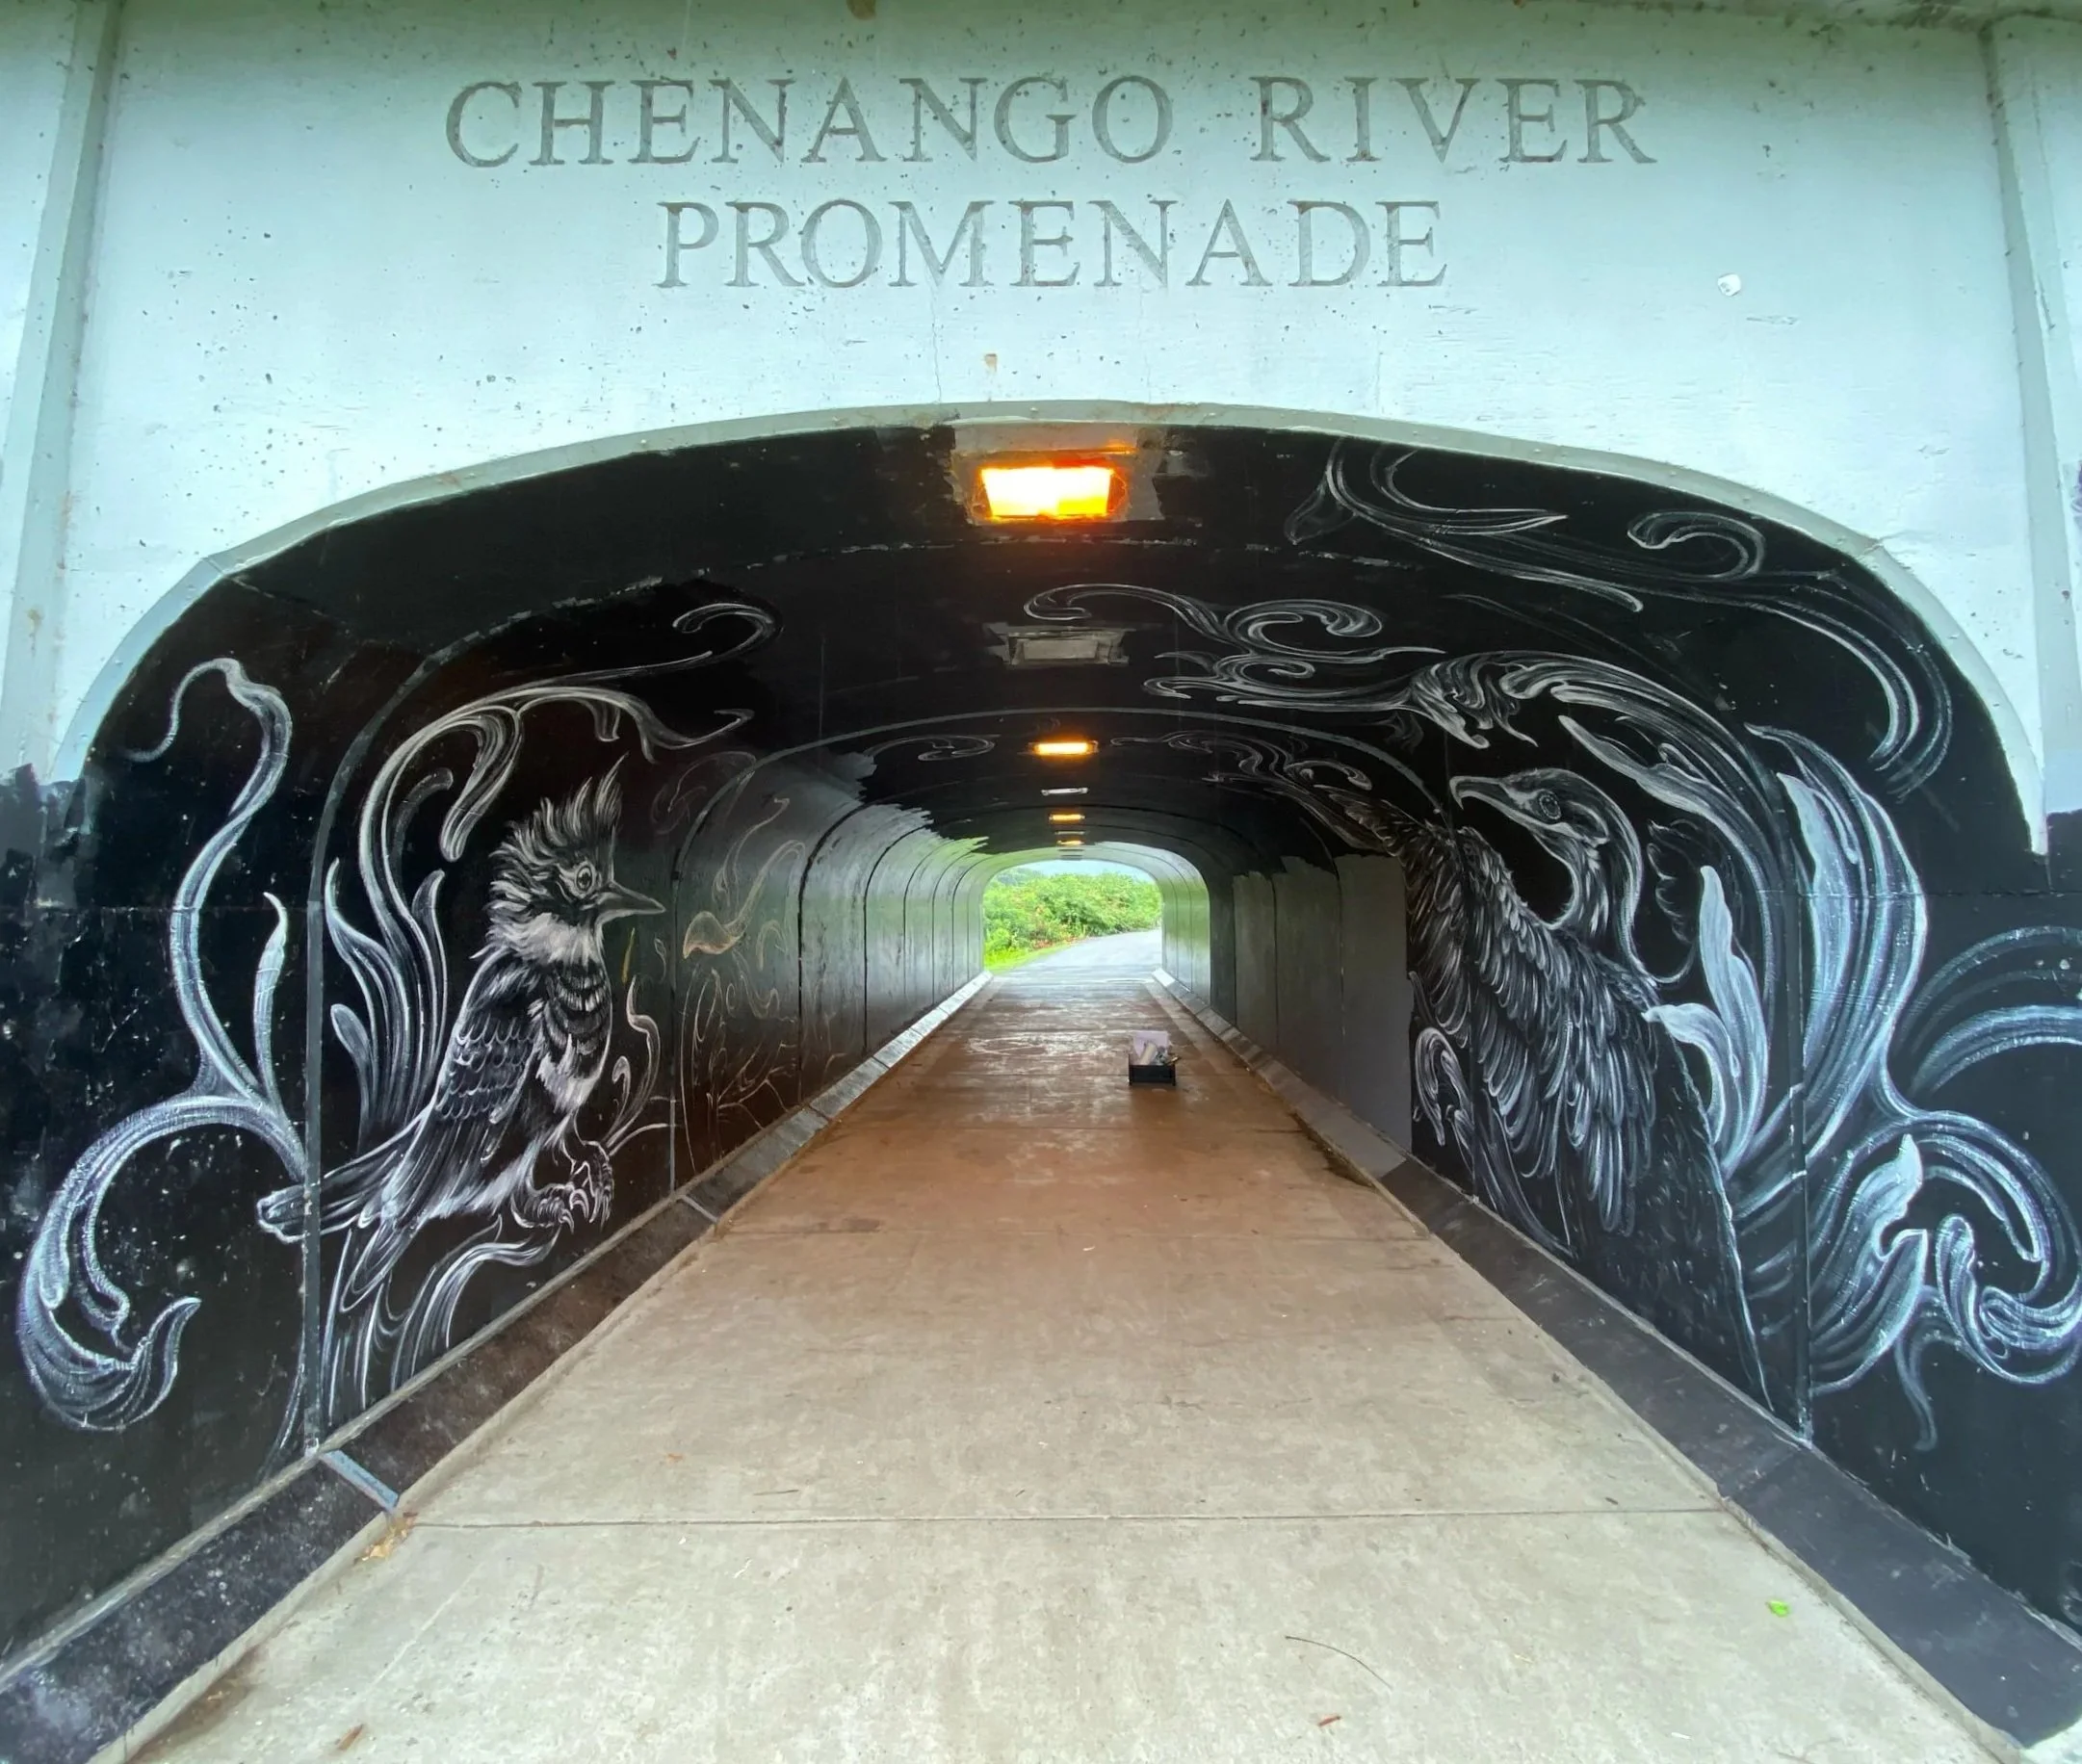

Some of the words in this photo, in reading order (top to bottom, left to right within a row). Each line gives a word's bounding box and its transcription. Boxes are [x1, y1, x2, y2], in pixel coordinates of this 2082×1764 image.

[446, 75, 1173, 168] CHENANGO
[1249, 76, 1657, 164] RIVER
[653, 198, 1446, 289] PROMENADE
